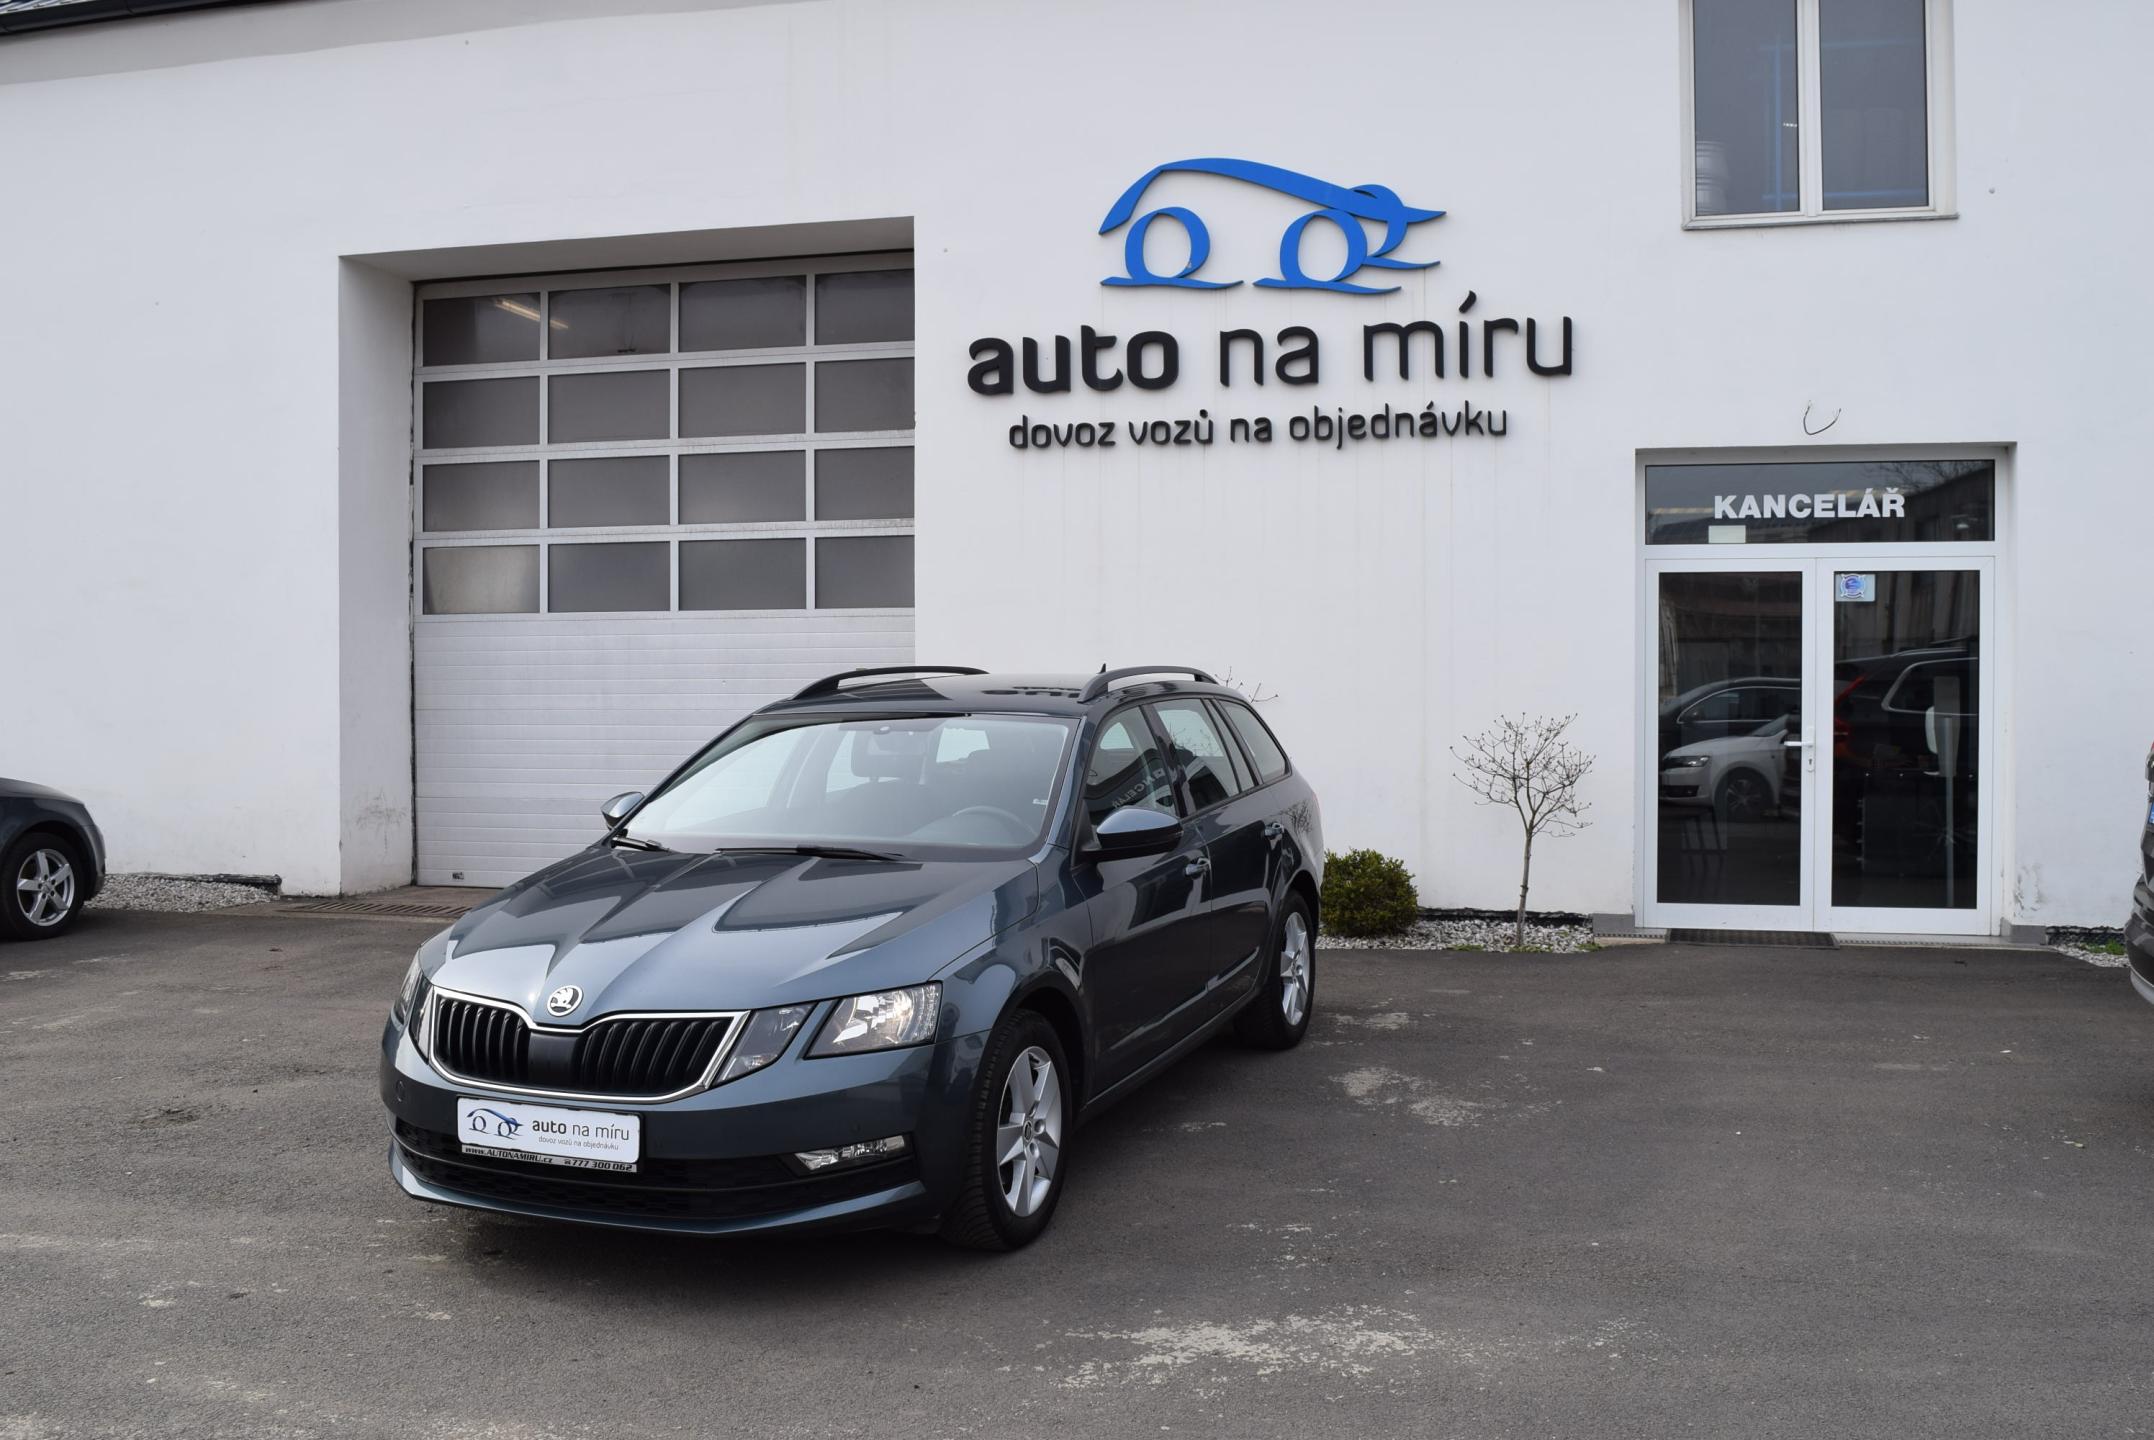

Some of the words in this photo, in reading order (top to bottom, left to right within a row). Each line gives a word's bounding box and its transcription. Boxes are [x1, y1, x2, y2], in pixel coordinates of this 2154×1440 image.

[968, 325, 1179, 397] auto
[1220, 326, 1319, 387] na
[1363, 291, 1572, 382] míru
[1009, 415, 1116, 450] dovoz
[1128, 409, 1214, 446] vozů
[1230, 417, 1273, 443] na
[1289, 401, 1508, 450] objednávku
[1714, 488, 1905, 519] KANCELÁŘ
[531, 1120, 567, 1135] auto
[572, 1124, 590, 1137] na
[595, 1123, 630, 1141] míru
[538, 1135, 556, 1144] dovoz
[592, 1161, 611, 1170] 300
